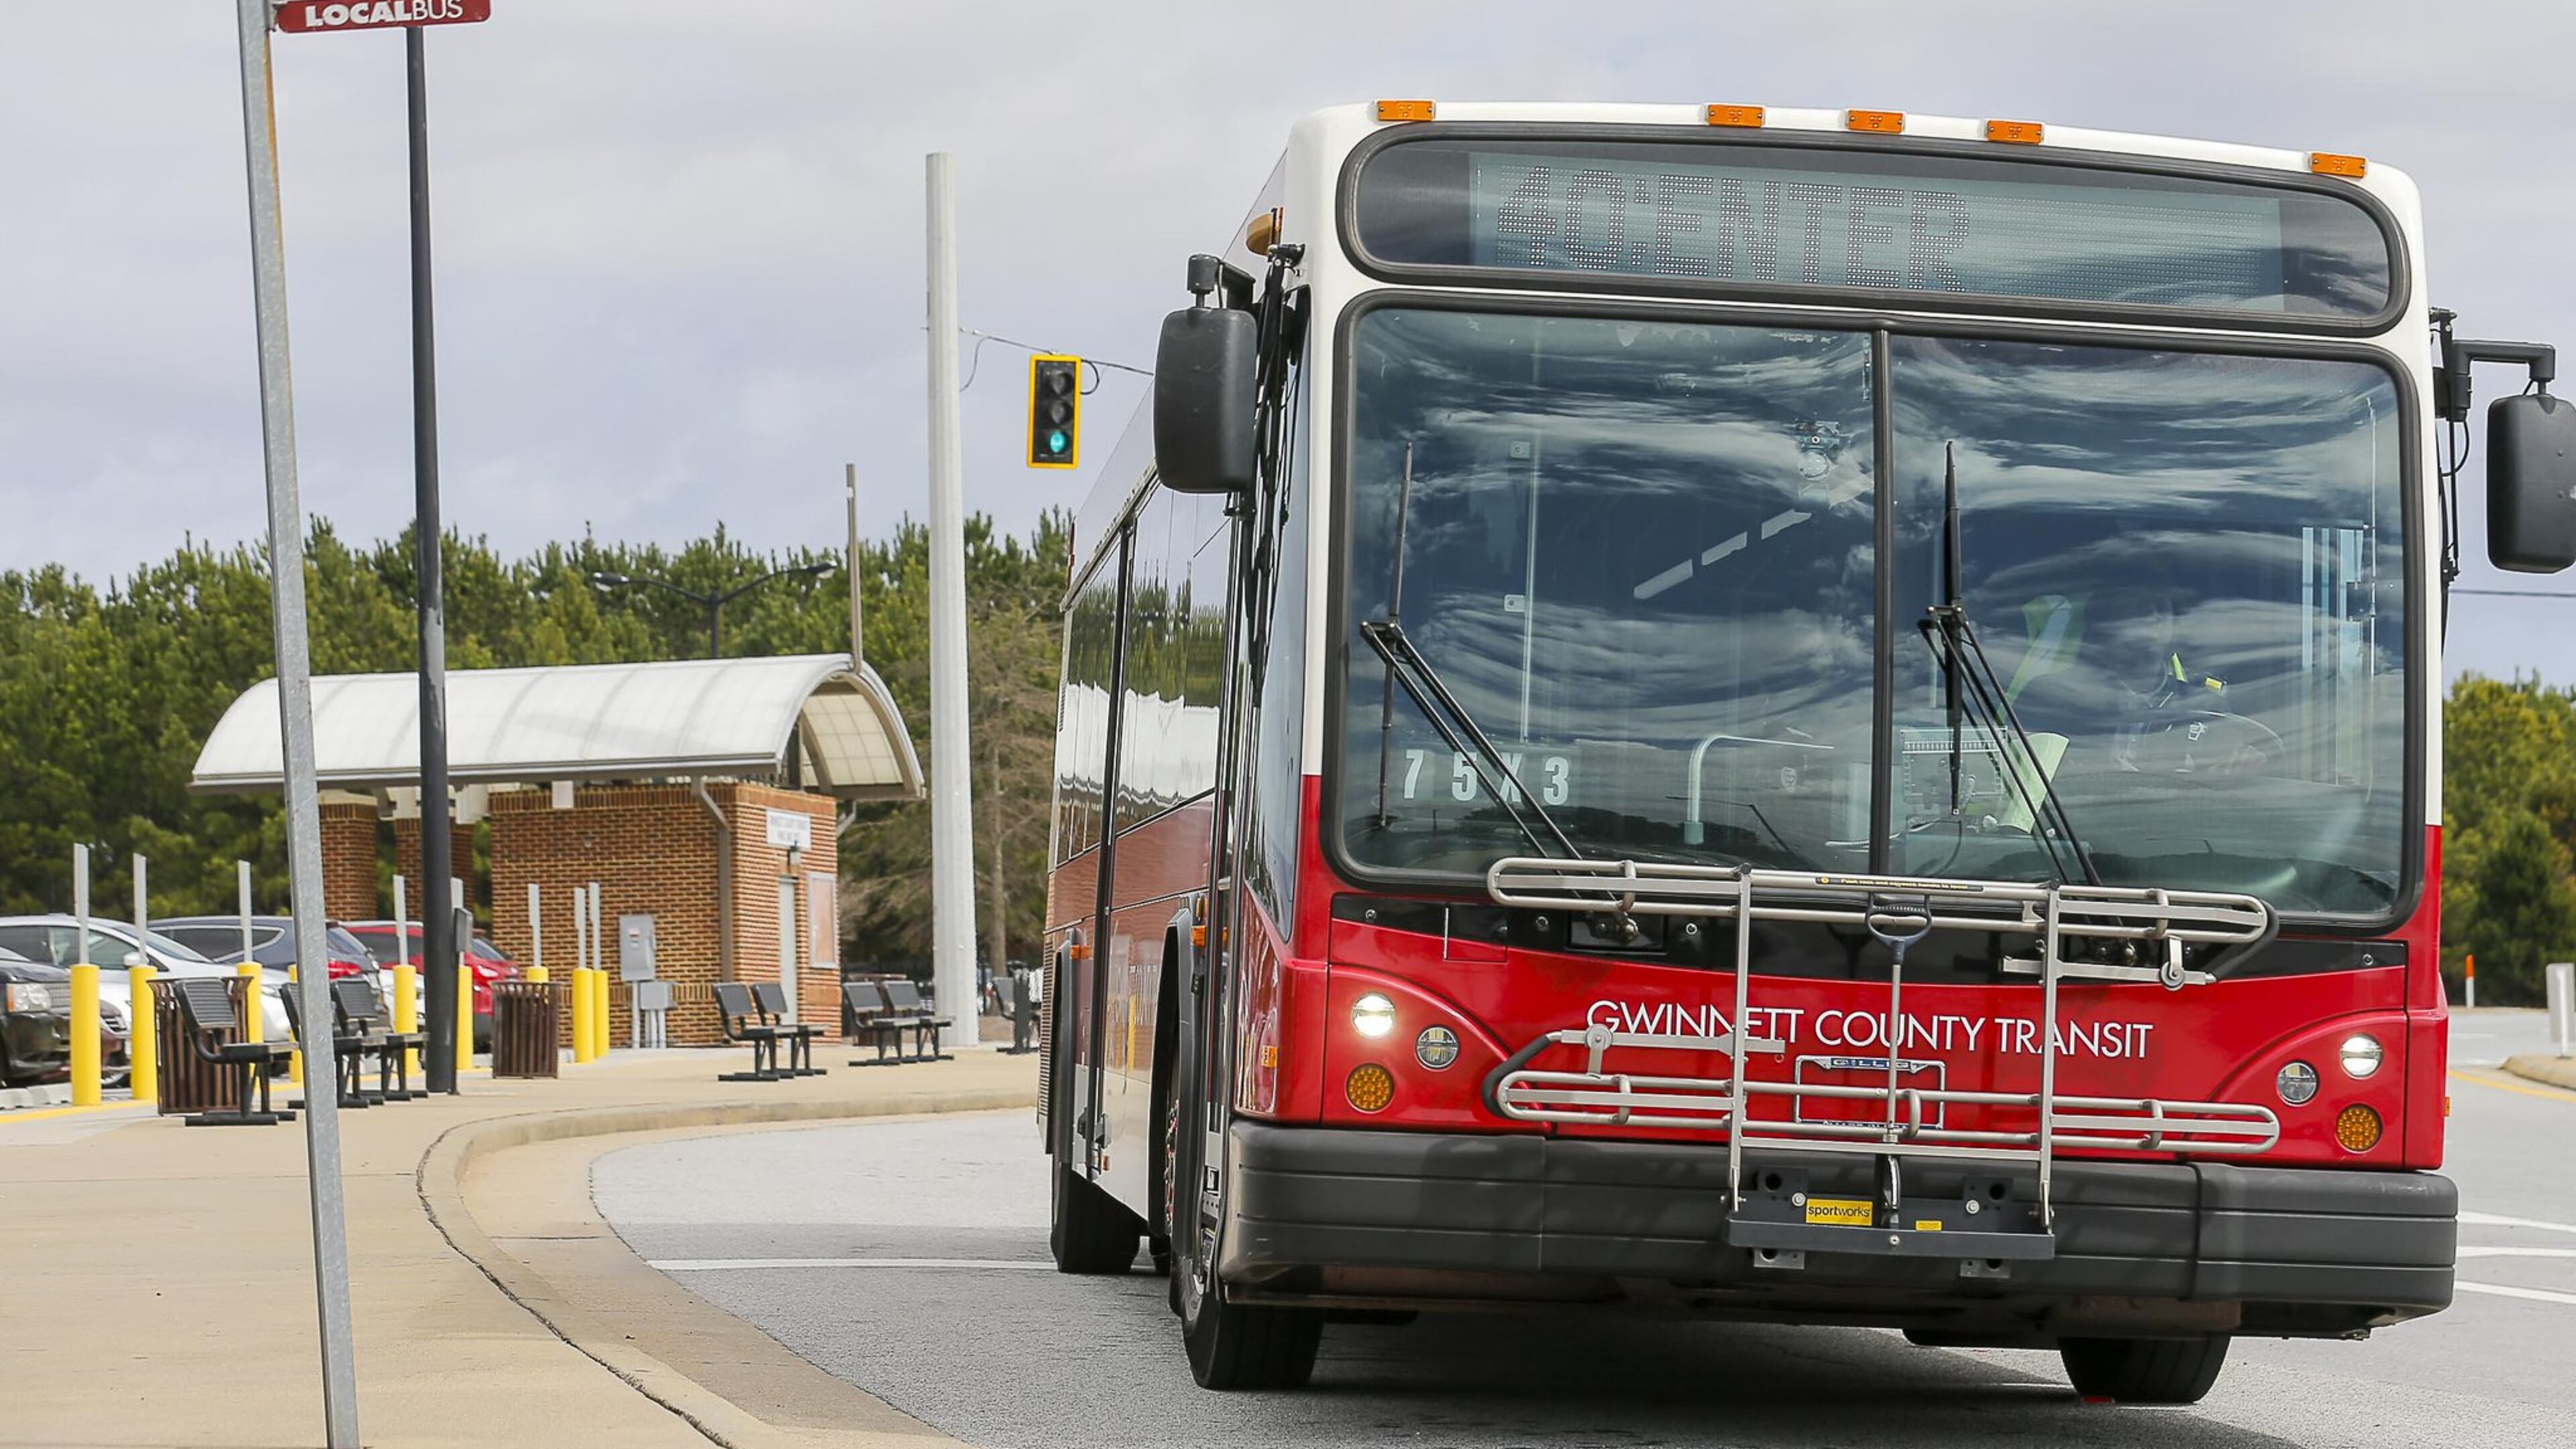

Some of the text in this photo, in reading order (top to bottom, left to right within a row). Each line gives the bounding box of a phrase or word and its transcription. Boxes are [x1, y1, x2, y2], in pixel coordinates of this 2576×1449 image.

[1587, 1000, 2154, 1058] GWINNETT COUNTY TRANSIT
[1808, 1205, 1870, 1218] sportworks
